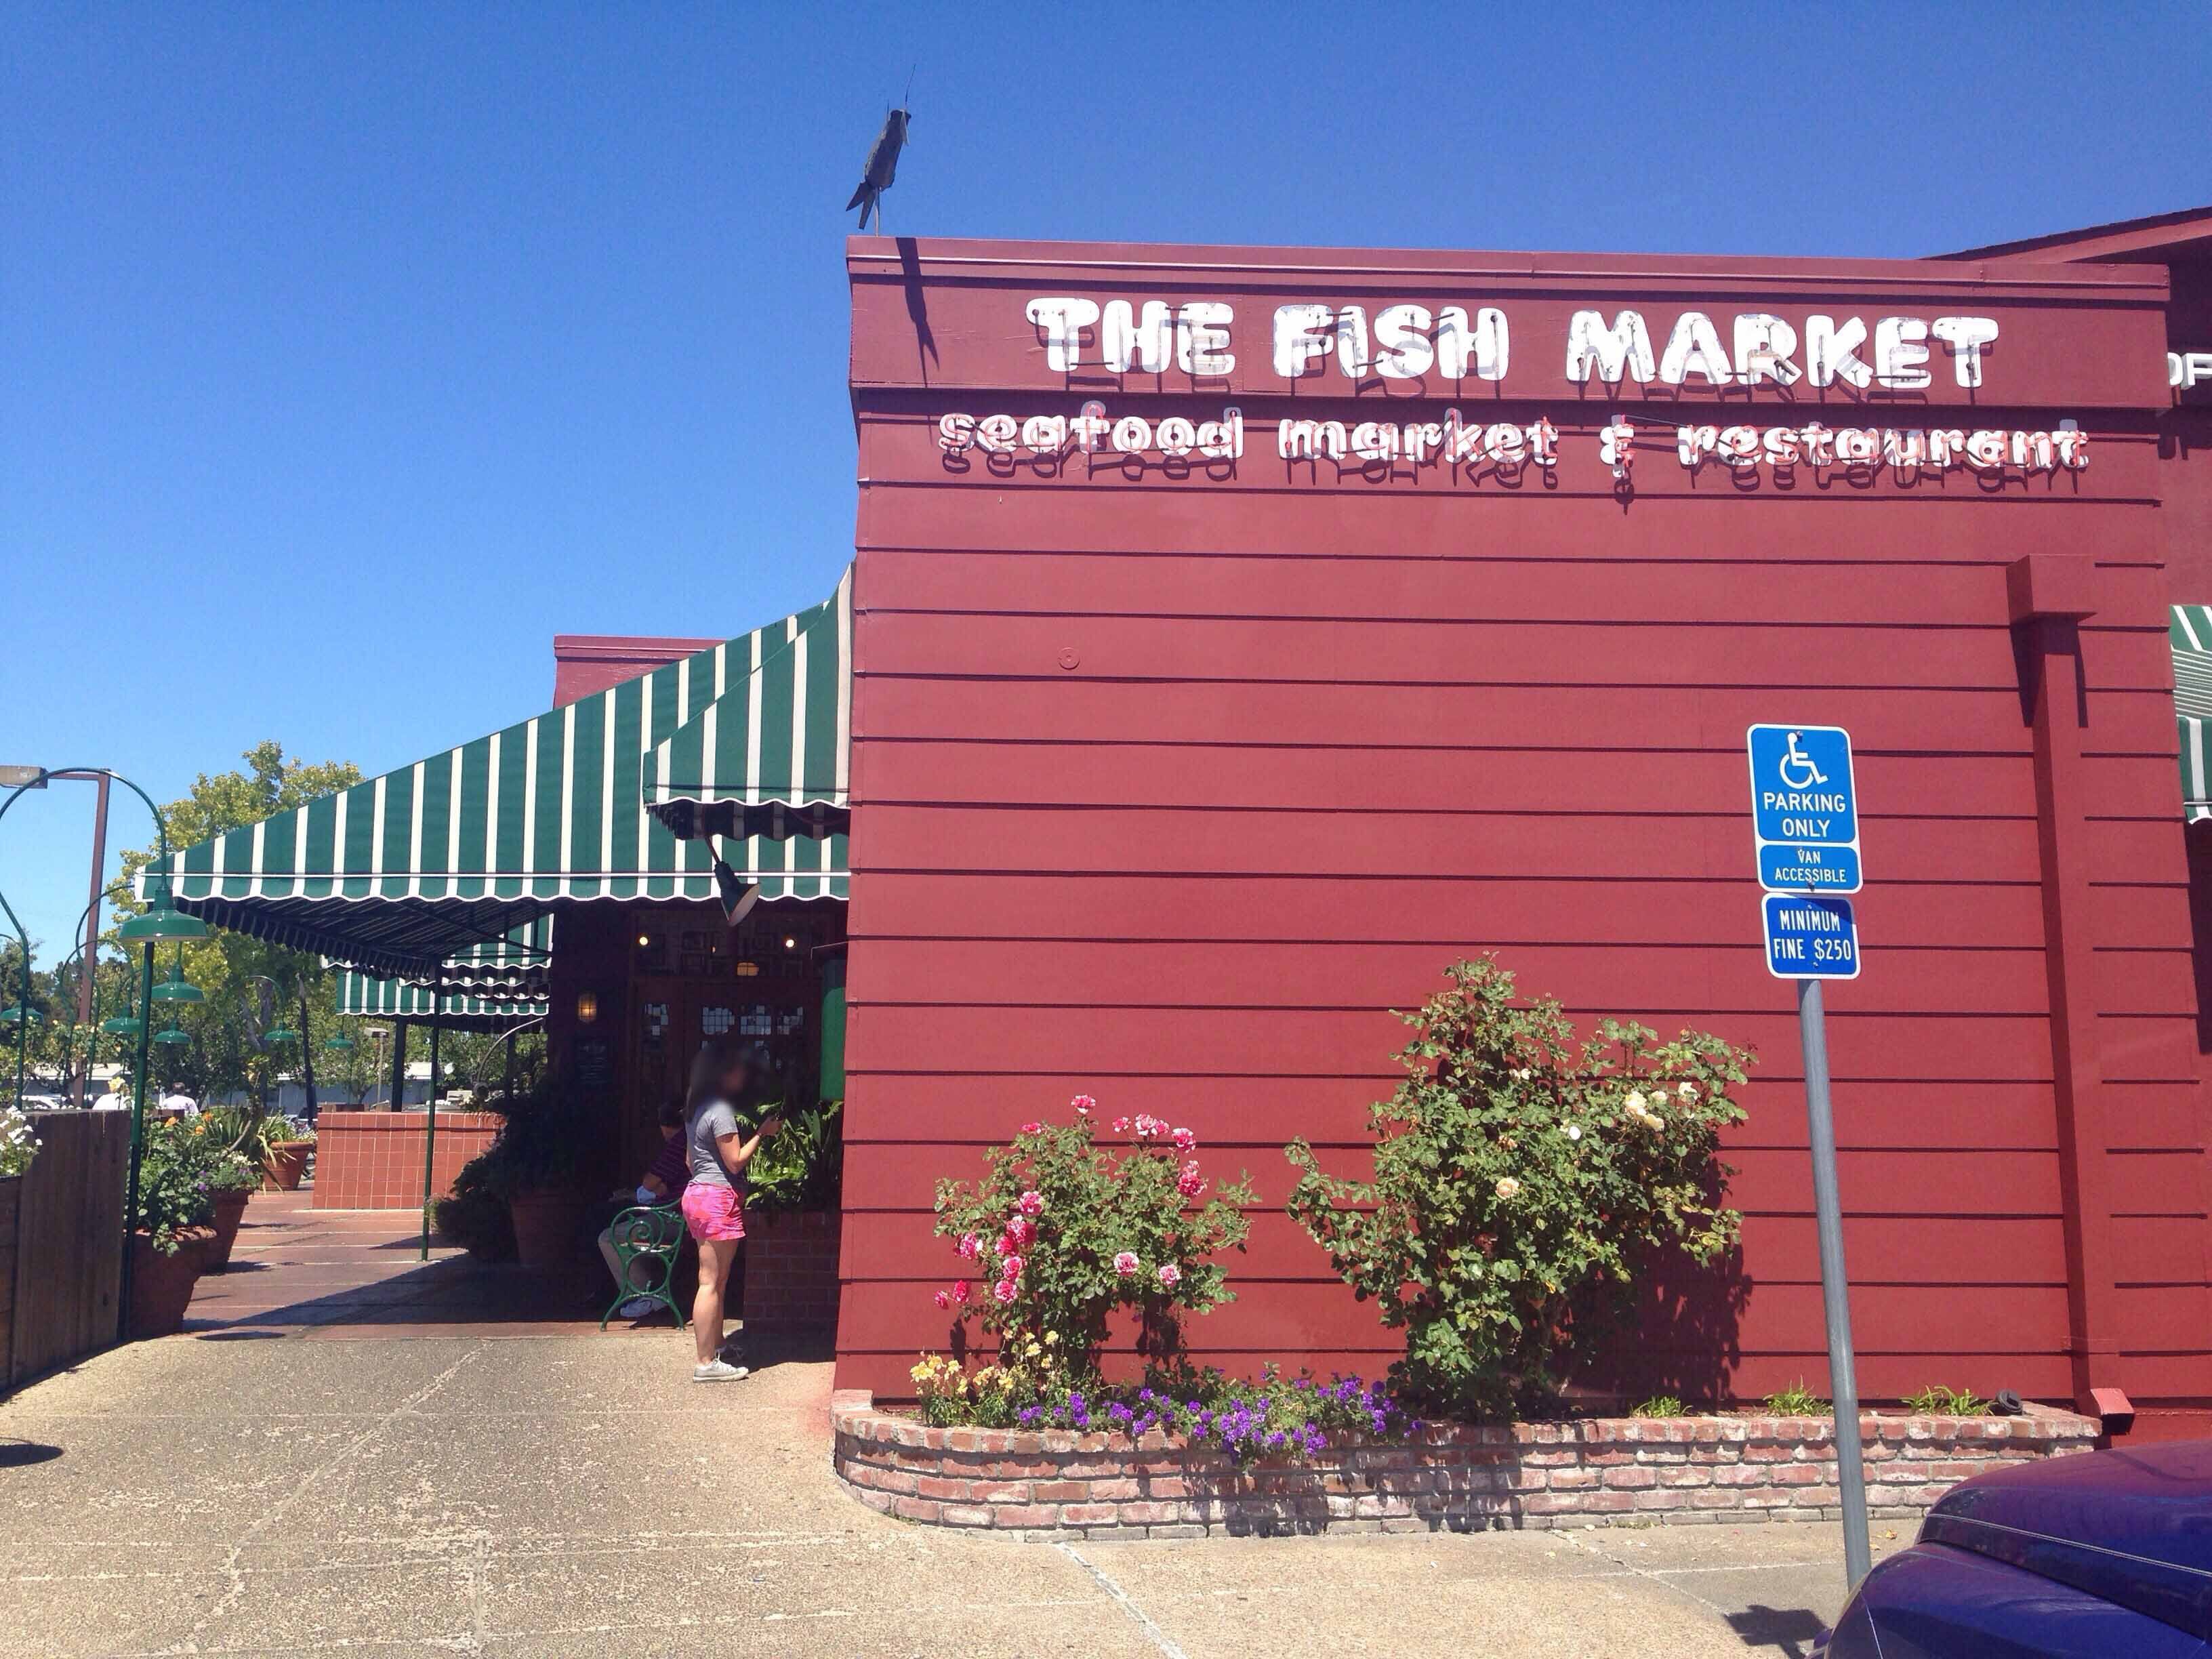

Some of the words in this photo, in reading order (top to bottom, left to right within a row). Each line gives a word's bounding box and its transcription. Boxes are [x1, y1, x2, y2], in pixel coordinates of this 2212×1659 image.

[1026, 298, 1235, 375] THE
[1273, 305, 1509, 380] FISH
[1567, 310, 1999, 388] MARKET
[939, 401, 1243, 459] seafood
[1279, 409, 1558, 465] market
[1677, 419, 2089, 468] restaurant
[1764, 792, 1845, 812] PARKING
[1783, 819, 1830, 837] ONLY
[1798, 849, 1820, 863] VAN
[1776, 867, 1846, 882] ACCESSIBLE
[1780, 910, 1840, 932] MINIMUM
[1774, 939, 1805, 959] FINE
[1814, 938, 1851, 961] $250
